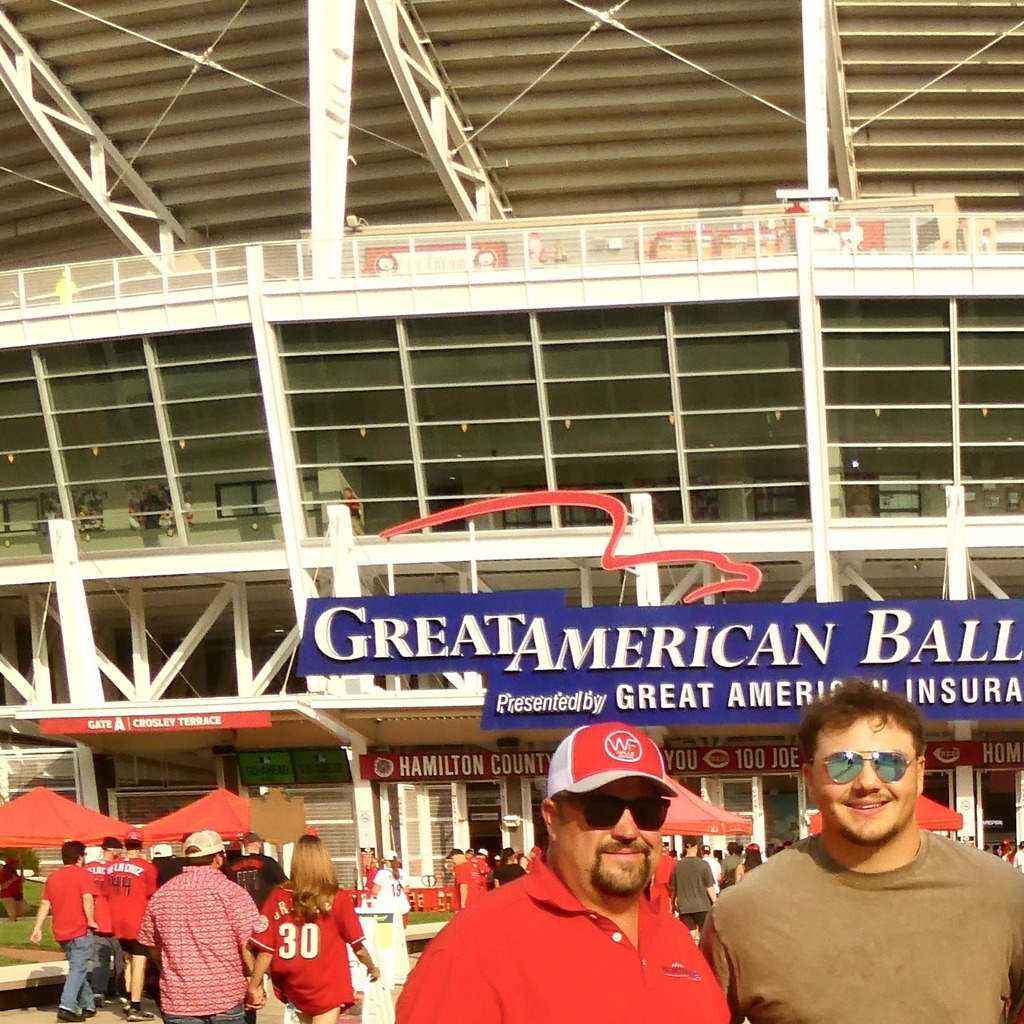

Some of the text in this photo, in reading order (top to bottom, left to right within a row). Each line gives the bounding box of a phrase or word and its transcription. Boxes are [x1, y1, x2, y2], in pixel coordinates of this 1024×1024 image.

[314, 606, 526, 661] GREAT
[504, 616, 838, 672] AMERICAN
[496, 690, 583, 714] Presented
[583, 690, 607, 714] by
[616, 683, 714, 711] GREAT
[727, 678, 888, 708] AMERIC
[88, 716, 222, 731] GATE A CROSLEY TERRACE
[400, 754, 484, 777] HAMILTON
[664, 749, 698, 770] YOU
[735, 747, 800, 769] 100 JOE
[278, 922, 320, 960] 30
